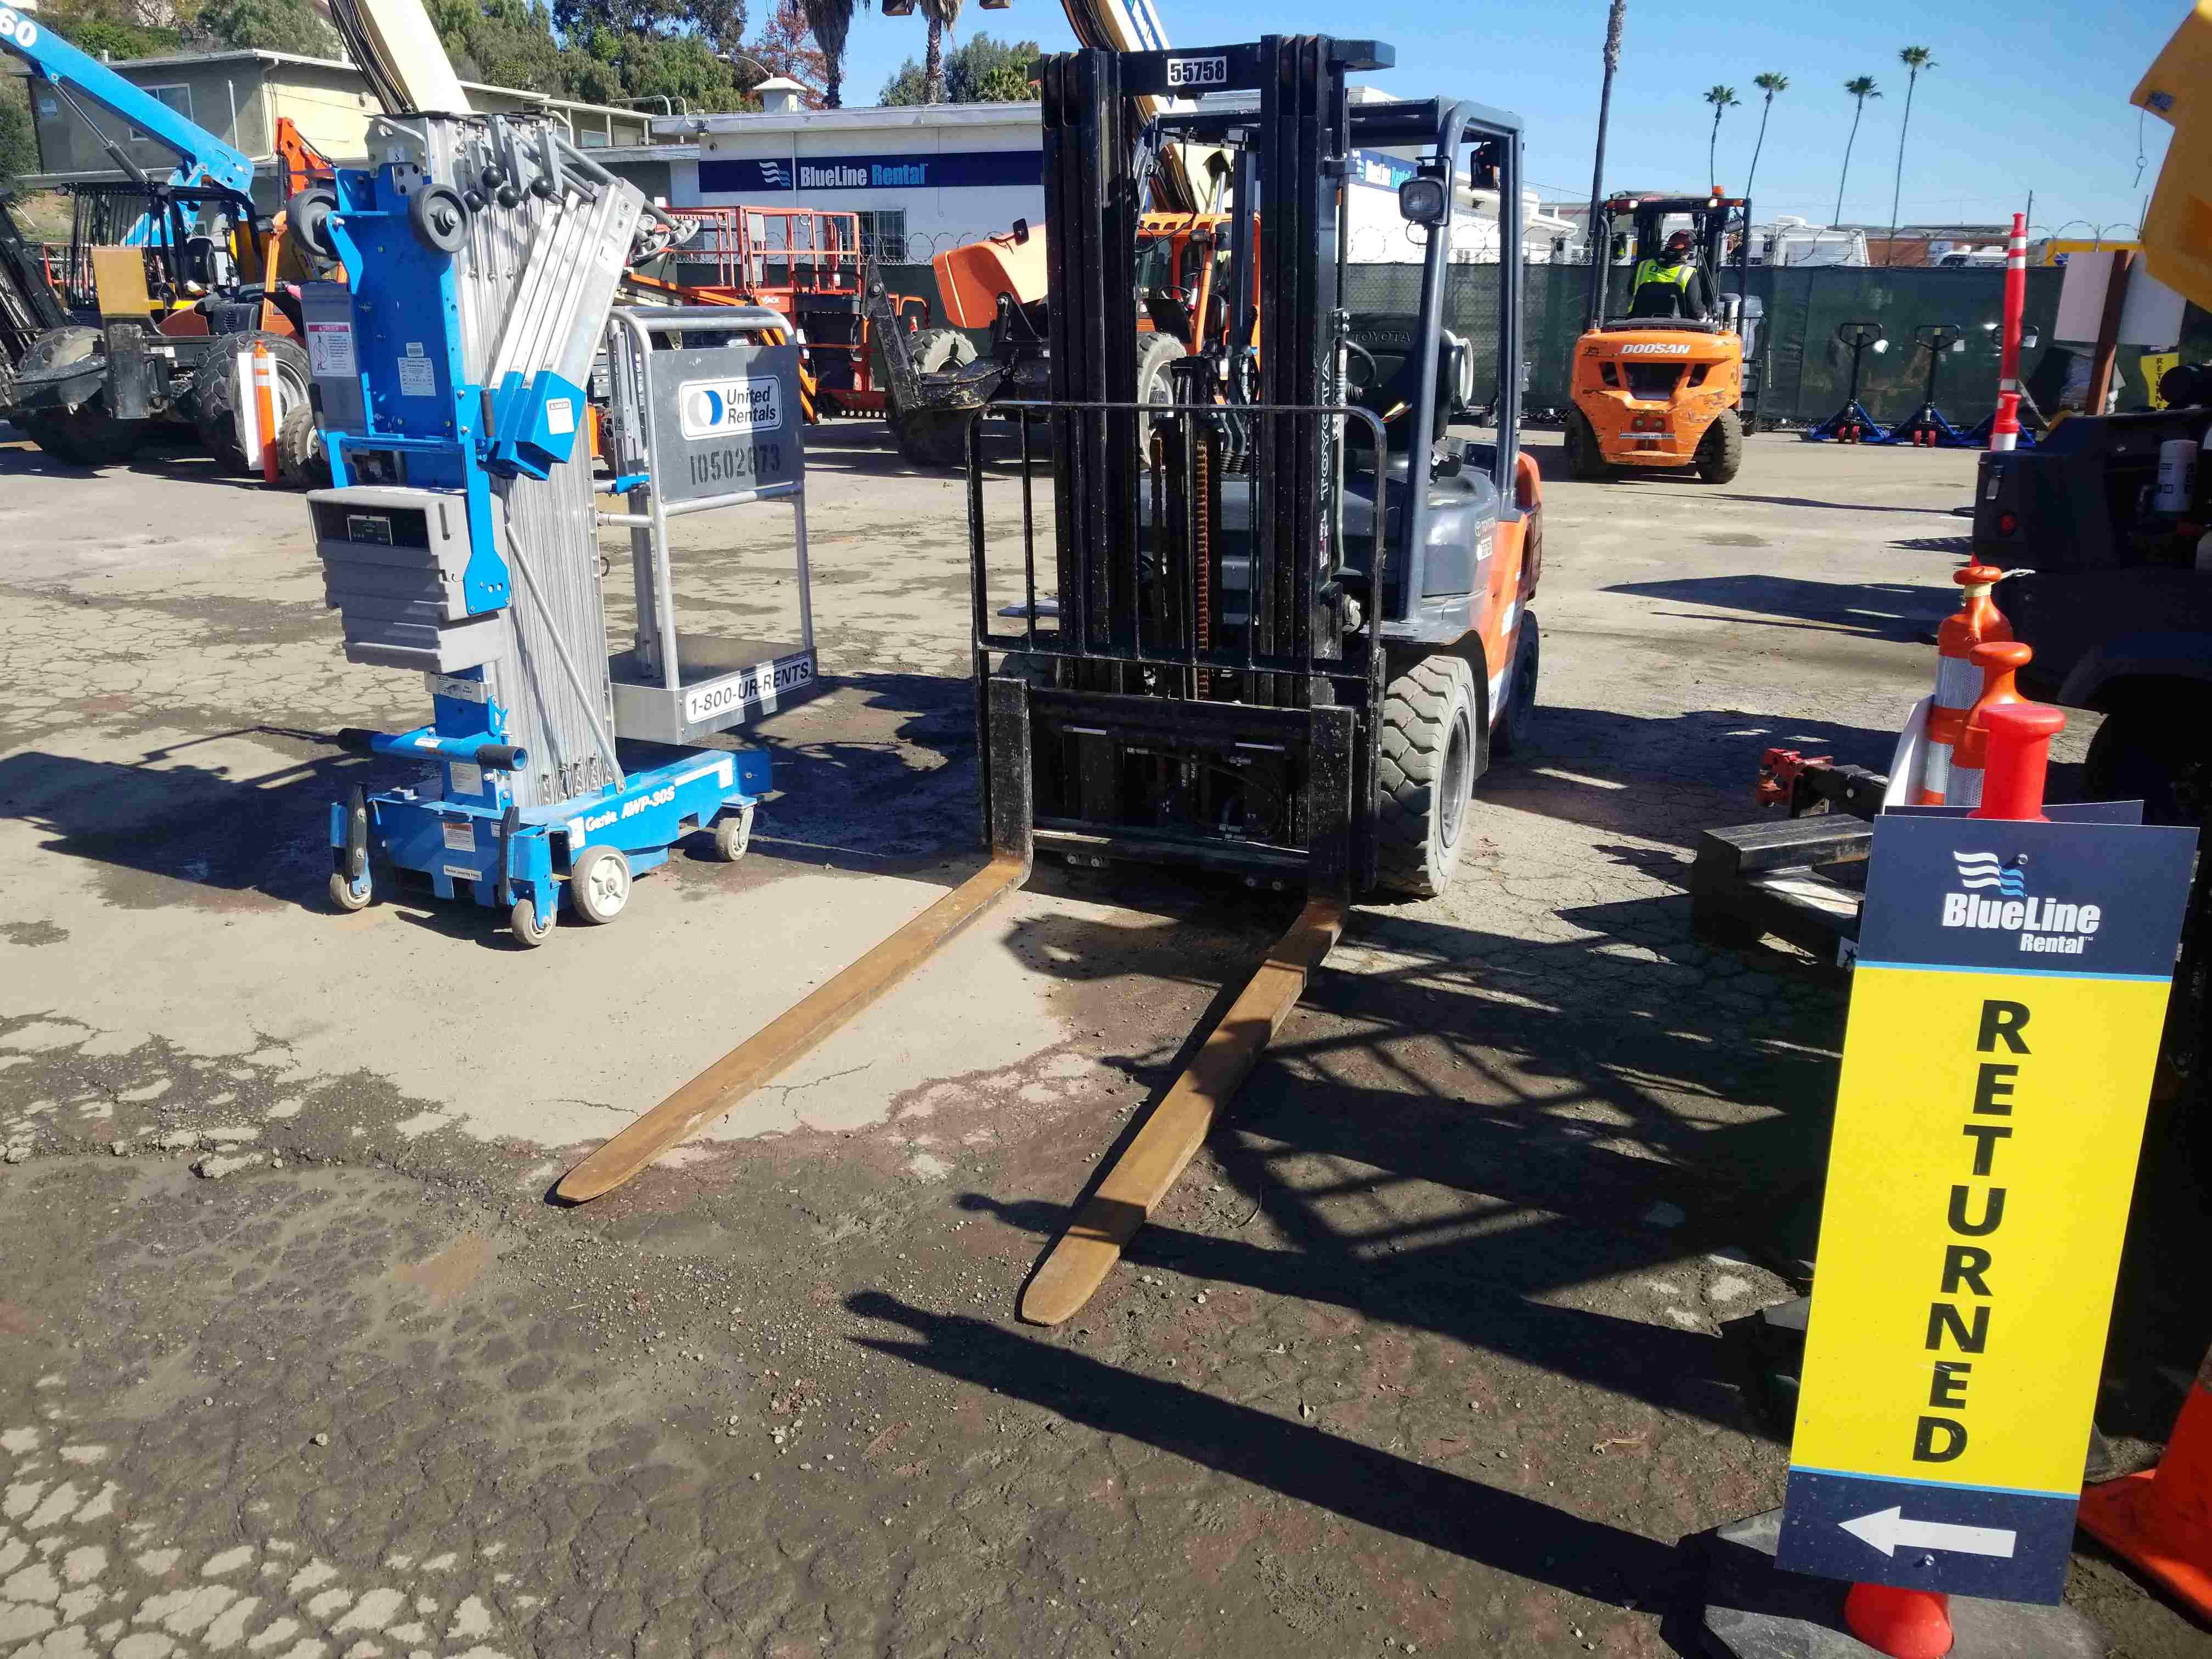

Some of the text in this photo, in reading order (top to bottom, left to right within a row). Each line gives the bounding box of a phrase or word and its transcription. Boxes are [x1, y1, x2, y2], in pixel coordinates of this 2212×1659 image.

[1170, 60, 1225, 82] 55758
[800, 166, 867, 187] BlueLine
[1353, 330, 1412, 343] TOYOTA
[1621, 344, 1691, 354] DOOSAN
[727, 385, 772, 405] United
[728, 404, 776, 425] Rentals
[691, 662, 809, 715] 1-800-UR-RENTS
[620, 785, 675, 820] AWP-30S
[1943, 893, 2100, 933] BlueLine
[1913, 1000, 2032, 1463] RETURNED
